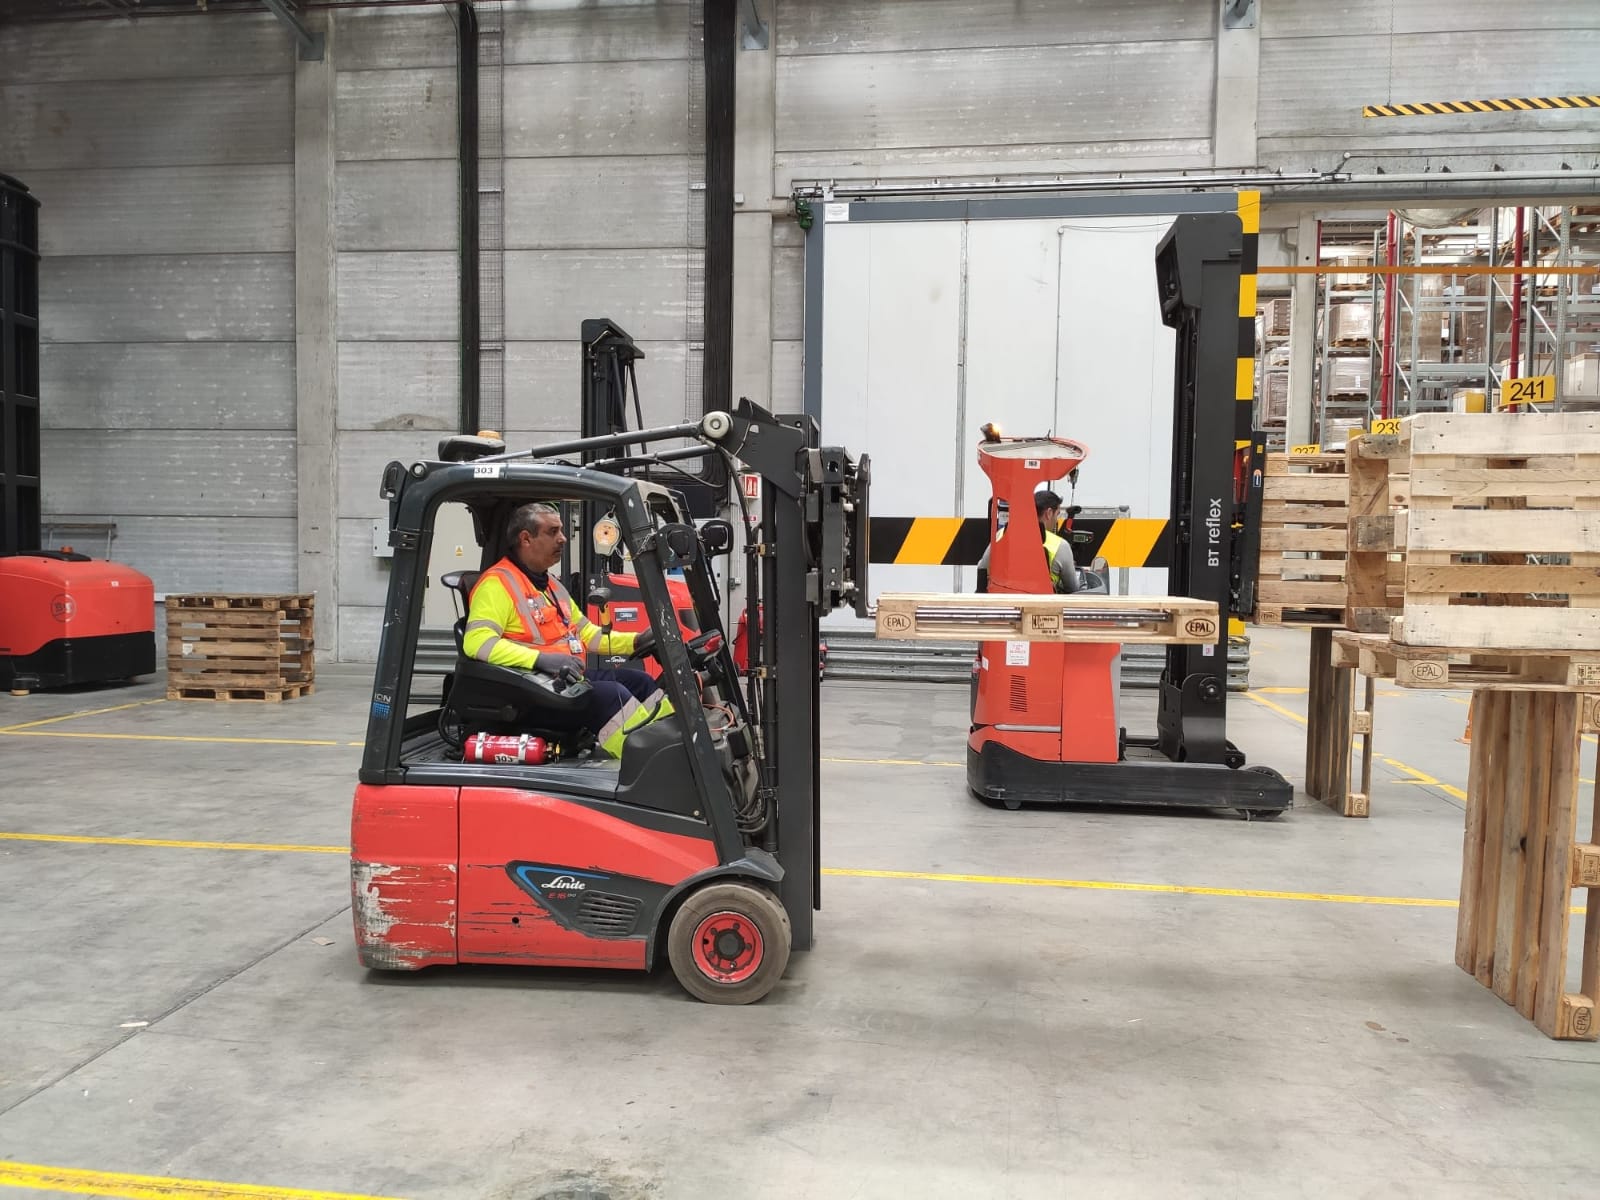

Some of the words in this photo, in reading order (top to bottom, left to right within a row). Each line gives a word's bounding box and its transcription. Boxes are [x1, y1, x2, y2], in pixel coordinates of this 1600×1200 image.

[1510, 380, 1544, 401] 241
[1205, 498, 1222, 544] reflex
[1207, 548, 1220, 567] BT
[887, 617, 907, 628] EPAL
[1190, 622, 1212, 633] EPAL
[1416, 665, 1439, 677] EPAL
[541, 875, 586, 890] Linde
[1576, 1009, 1589, 1031] EPAL
